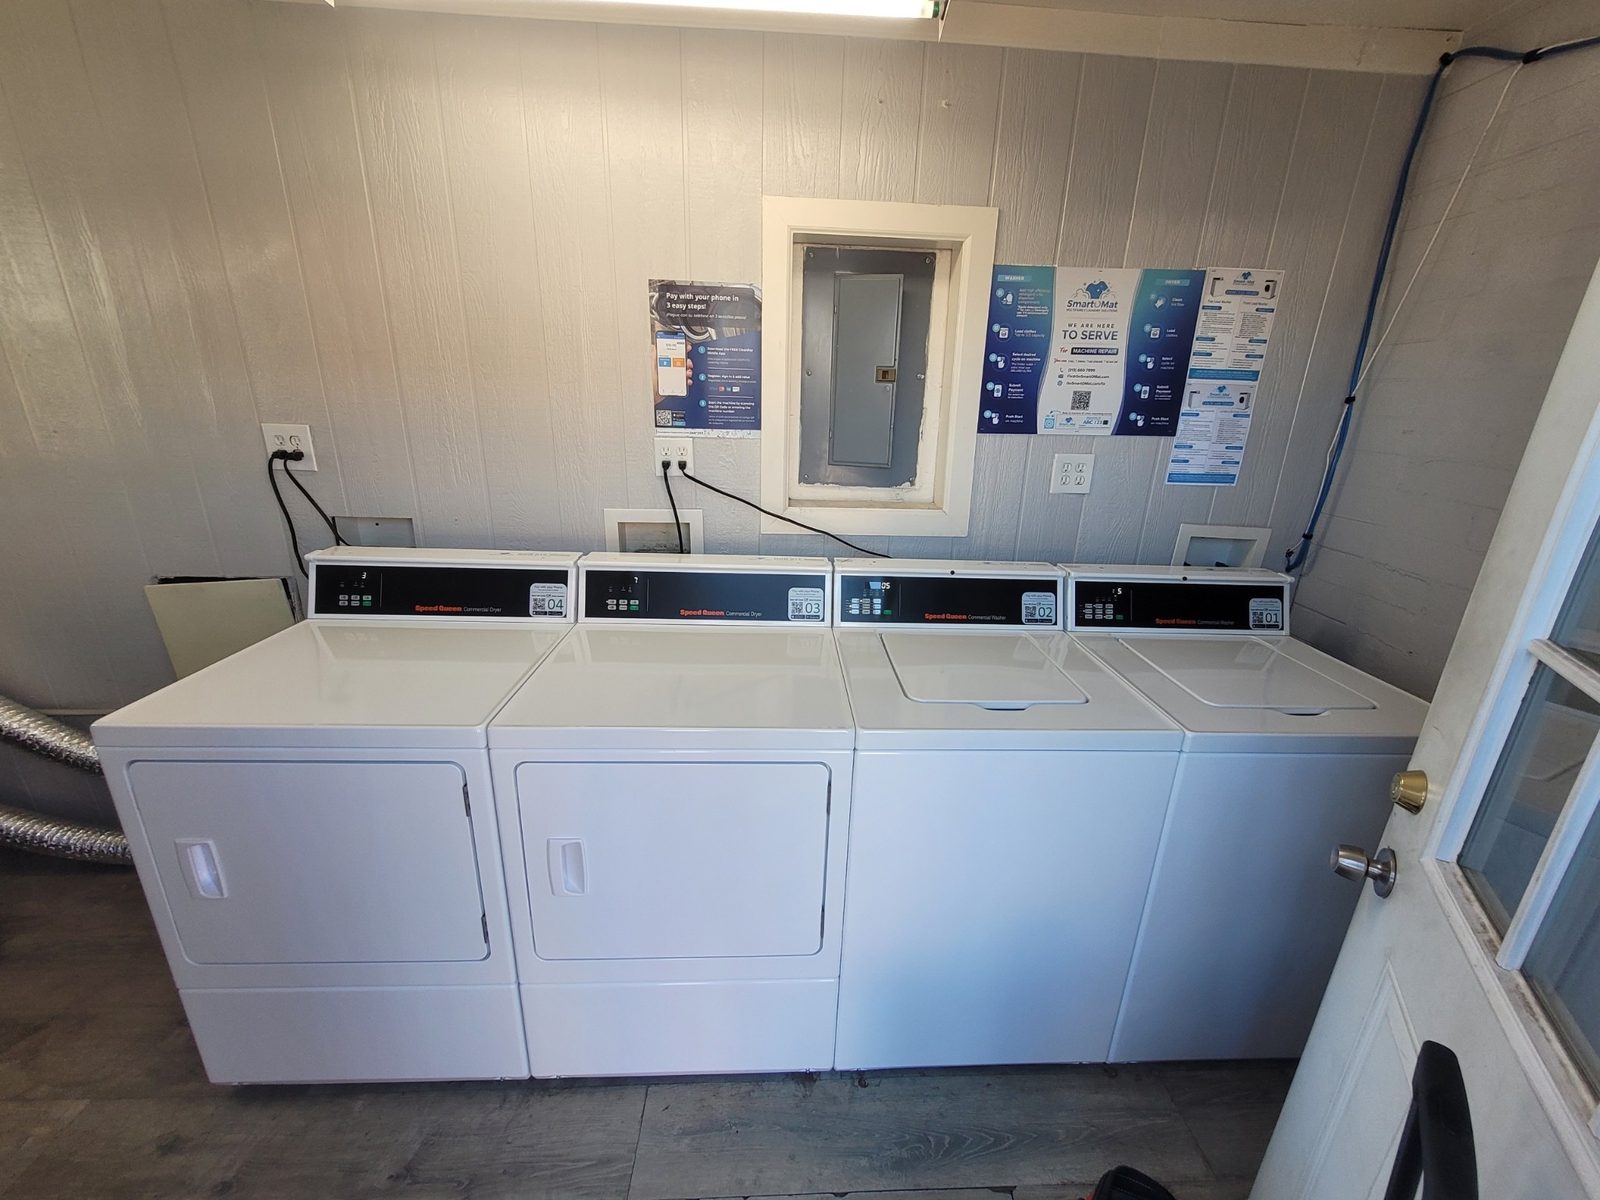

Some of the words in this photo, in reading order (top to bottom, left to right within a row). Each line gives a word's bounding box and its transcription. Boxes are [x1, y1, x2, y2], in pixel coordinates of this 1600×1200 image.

[711, 294, 731, 302] phone
[688, 303, 706, 311] steps!
[1062, 330, 1078, 340] TO
[1081, 331, 1118, 340] SERVE
[547, 599, 564, 610] 04
[805, 603, 820, 613] 03
[1038, 607, 1053, 617] 02
[1265, 613, 1279, 623] 01
